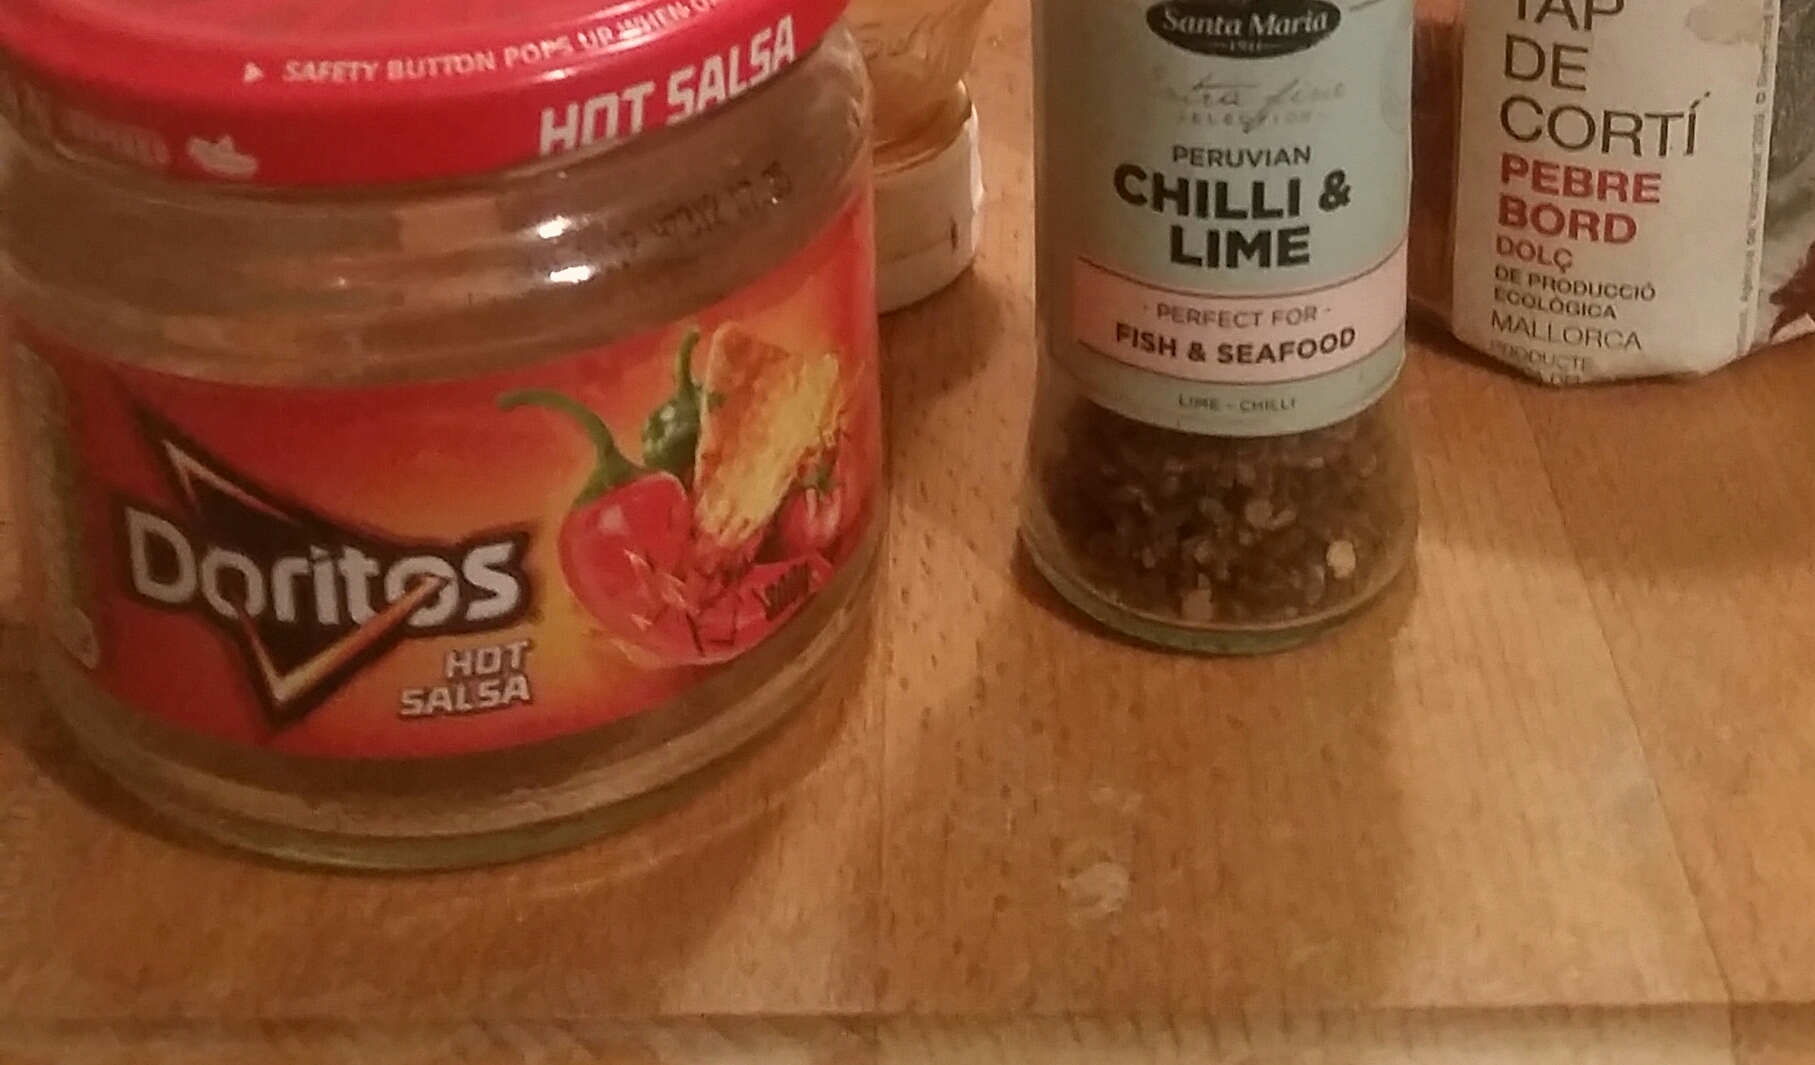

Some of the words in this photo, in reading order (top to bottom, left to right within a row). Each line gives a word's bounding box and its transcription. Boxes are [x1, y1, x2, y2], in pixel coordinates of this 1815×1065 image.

[1162, 5, 1243, 36] Santa
[1247, 8, 1329, 37] Maria
[283, 58, 379, 83] SAFETY
[387, 46, 496, 82] BUTTON
[504, 35, 574, 68] POPS
[577, 25, 614, 50] UP
[1503, 33, 1589, 92] DE
[538, 80, 656, 157] HOT
[665, 13, 797, 122] SALSA
[1499, 90, 1711, 158] CORTÍ
[1172, 143, 1312, 169] PERUVIAN
[1500, 152, 1662, 205] PEBRE
[1113, 163, 1302, 220] CHILLI
[1317, 168, 1352, 213] &
[1498, 192, 1638, 245] BORD
[1169, 224, 1311, 270] LIME
[1495, 234, 1574, 274] DOLÇ
[1494, 265, 1519, 285] DE
[1527, 272, 1656, 302] PRODUCCIÓ
[1155, 302, 1263, 329] PERFECT
[1271, 305, 1318, 328] FOR
[1490, 309, 1643, 352] MALLORCA
[1115, 322, 1177, 359] FISH
[1187, 341, 1206, 364] &
[1217, 327, 1357, 366] SEAFOOD
[1178, 393, 1219, 412] LIME
[1239, 397, 1297, 412] CHILLI
[124, 505, 520, 627] Doritos
[443, 640, 531, 680] HOT
[397, 673, 533, 718] SALSA
